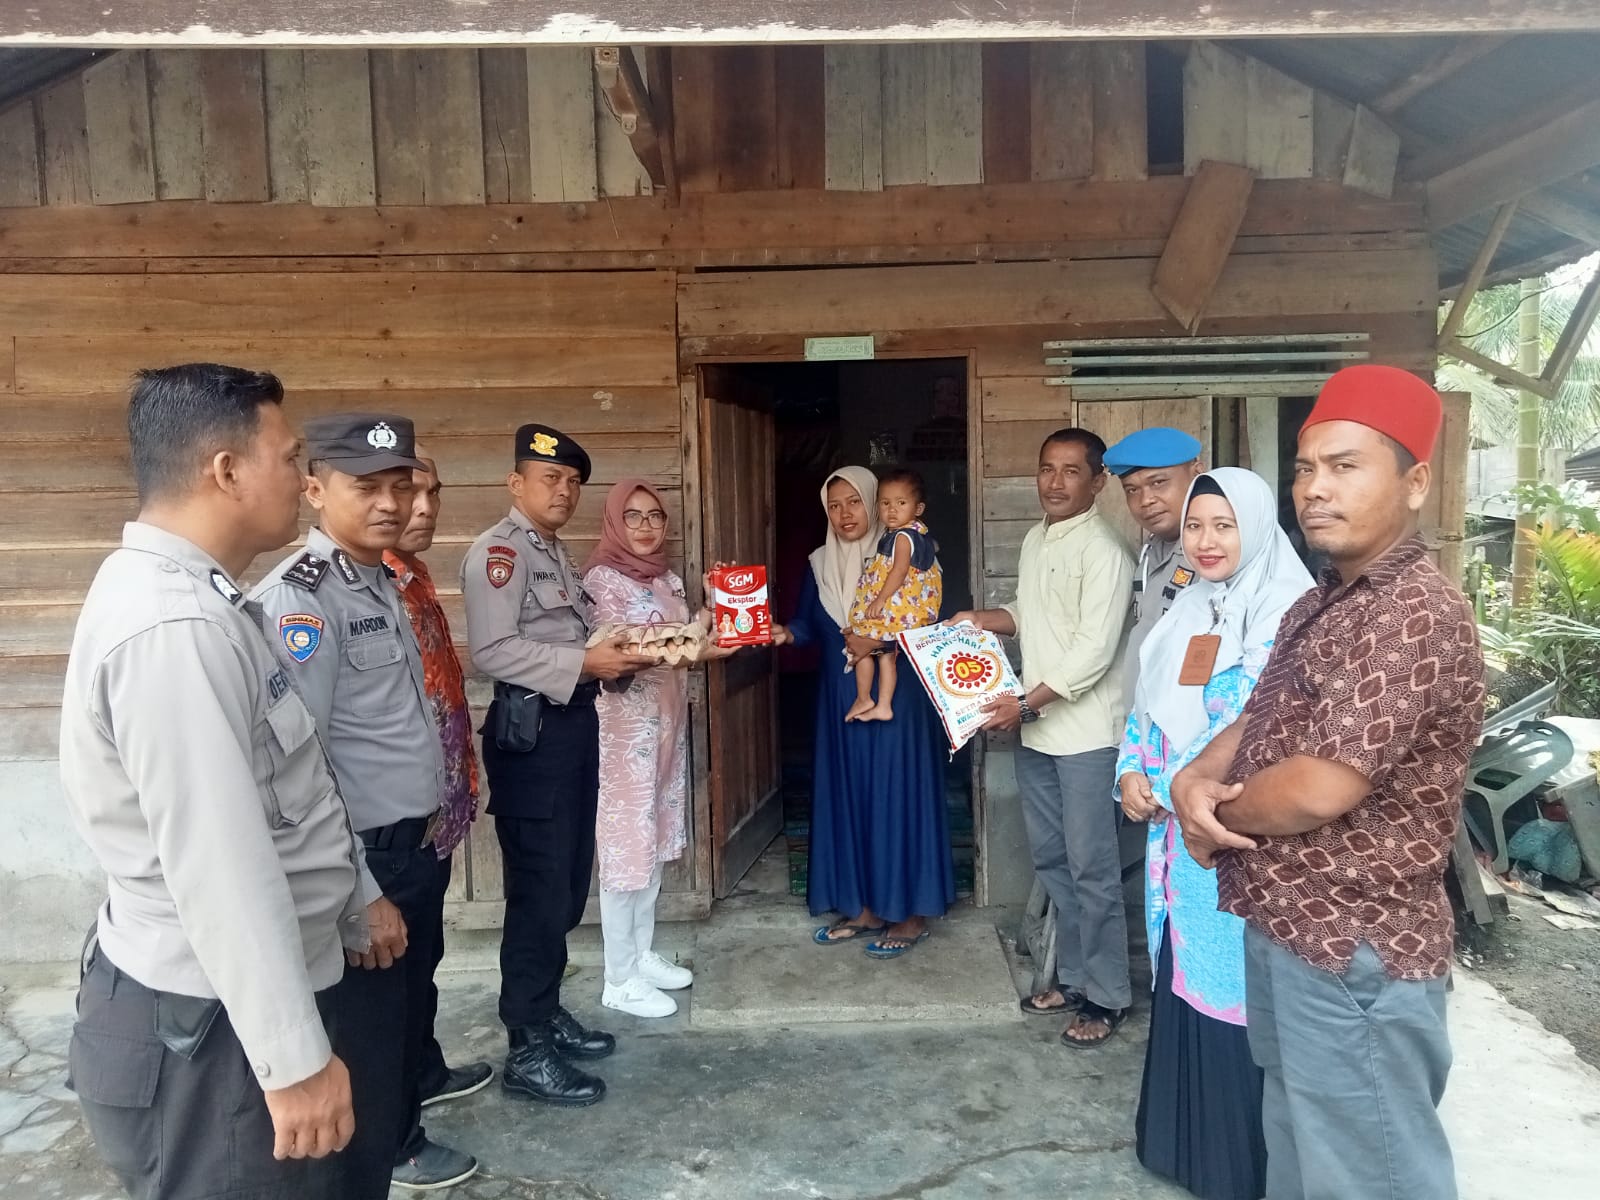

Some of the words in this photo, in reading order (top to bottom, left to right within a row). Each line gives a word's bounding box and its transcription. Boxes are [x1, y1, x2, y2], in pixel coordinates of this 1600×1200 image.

[728, 572, 754, 589] SGM
[727, 596, 757, 605] Eksplor
[955, 661, 982, 679] 05
[984, 689, 1016, 703] RAMOS
